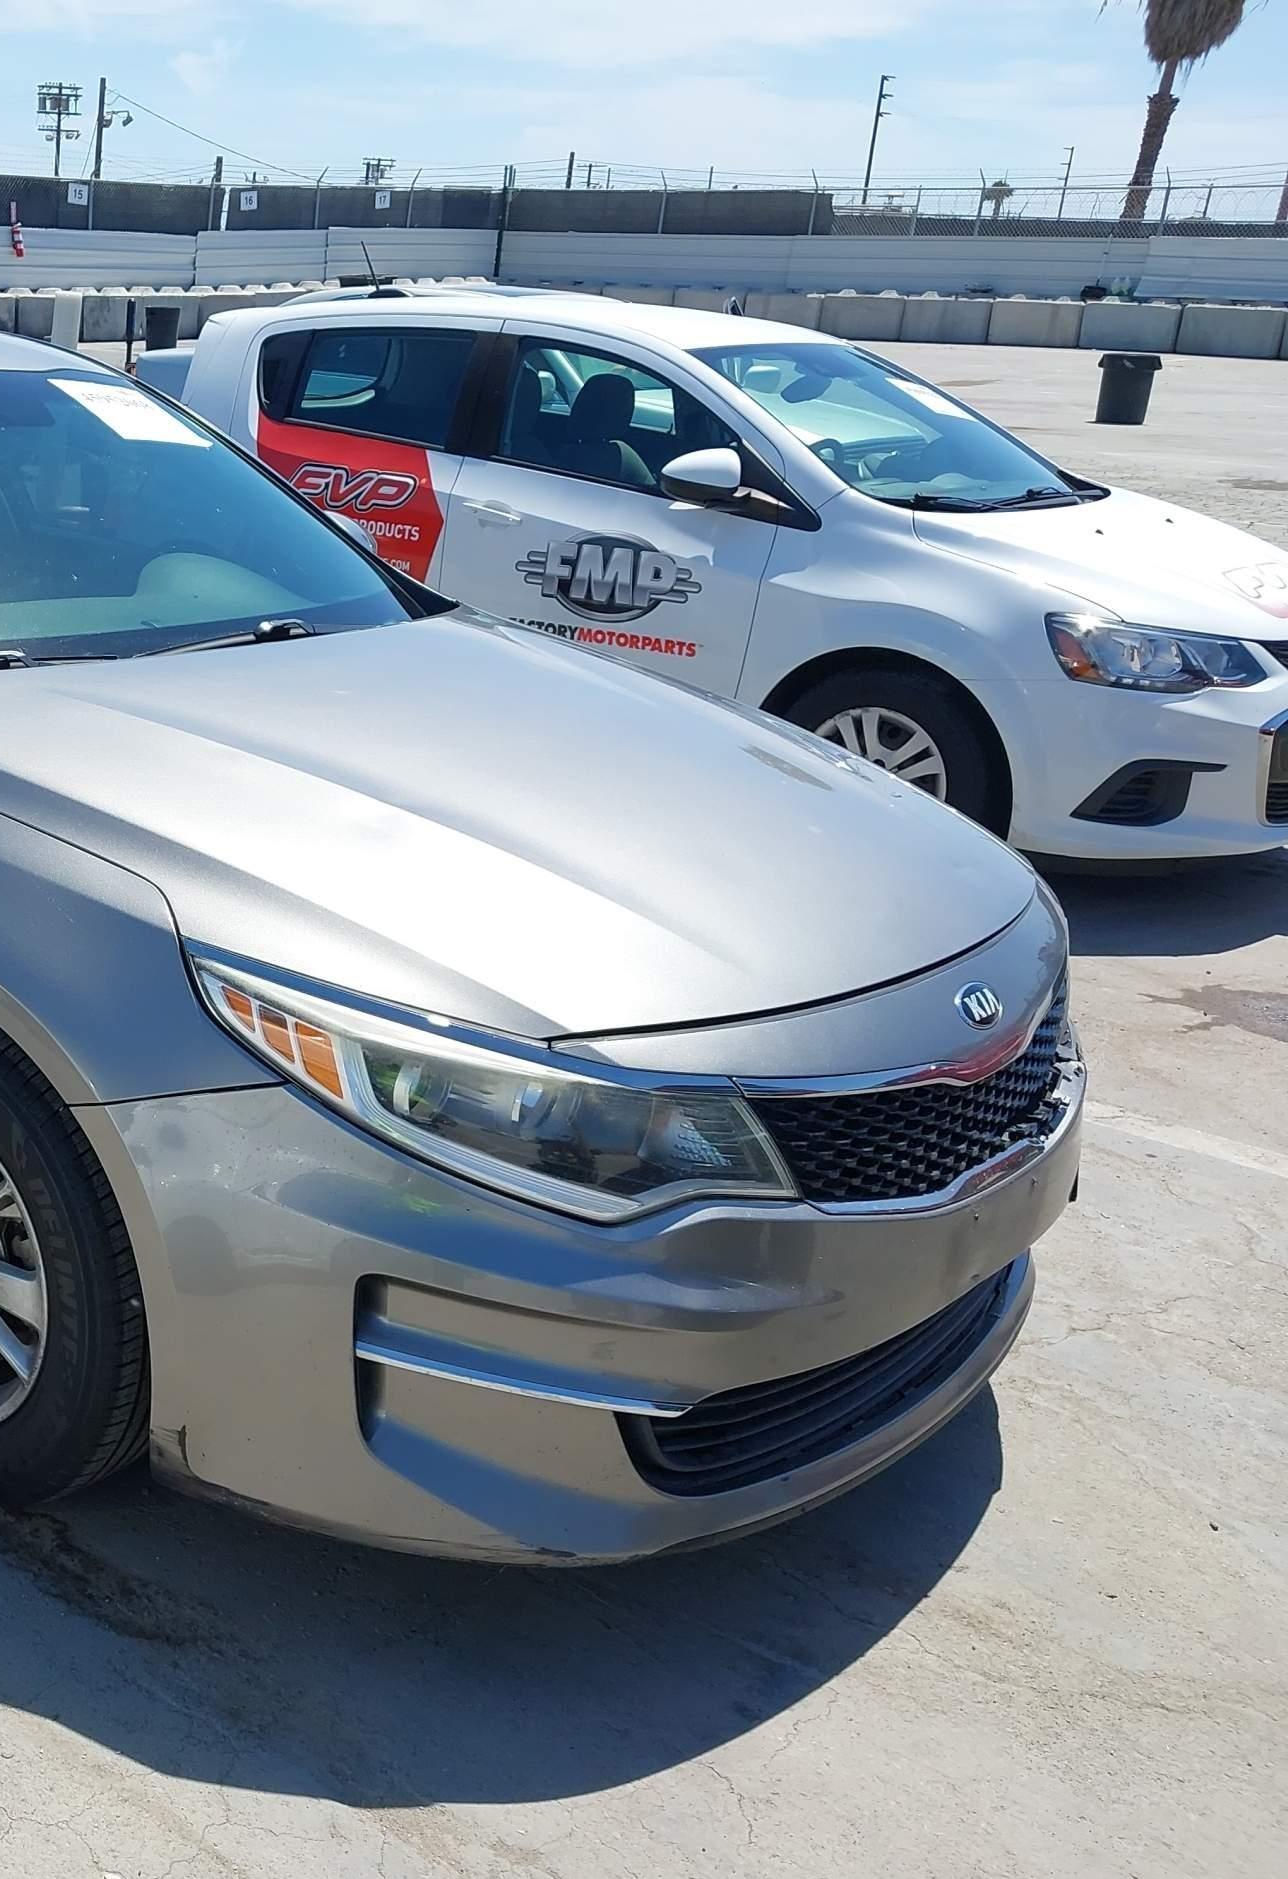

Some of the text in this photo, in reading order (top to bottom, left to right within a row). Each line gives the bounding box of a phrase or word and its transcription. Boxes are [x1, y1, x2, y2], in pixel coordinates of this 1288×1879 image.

[353, 518, 420, 541] RODUCTS
[541, 541, 677, 607] FMP
[509, 617, 696, 657] TORYMOTORPARTS
[962, 988, 1001, 1022] KIA
